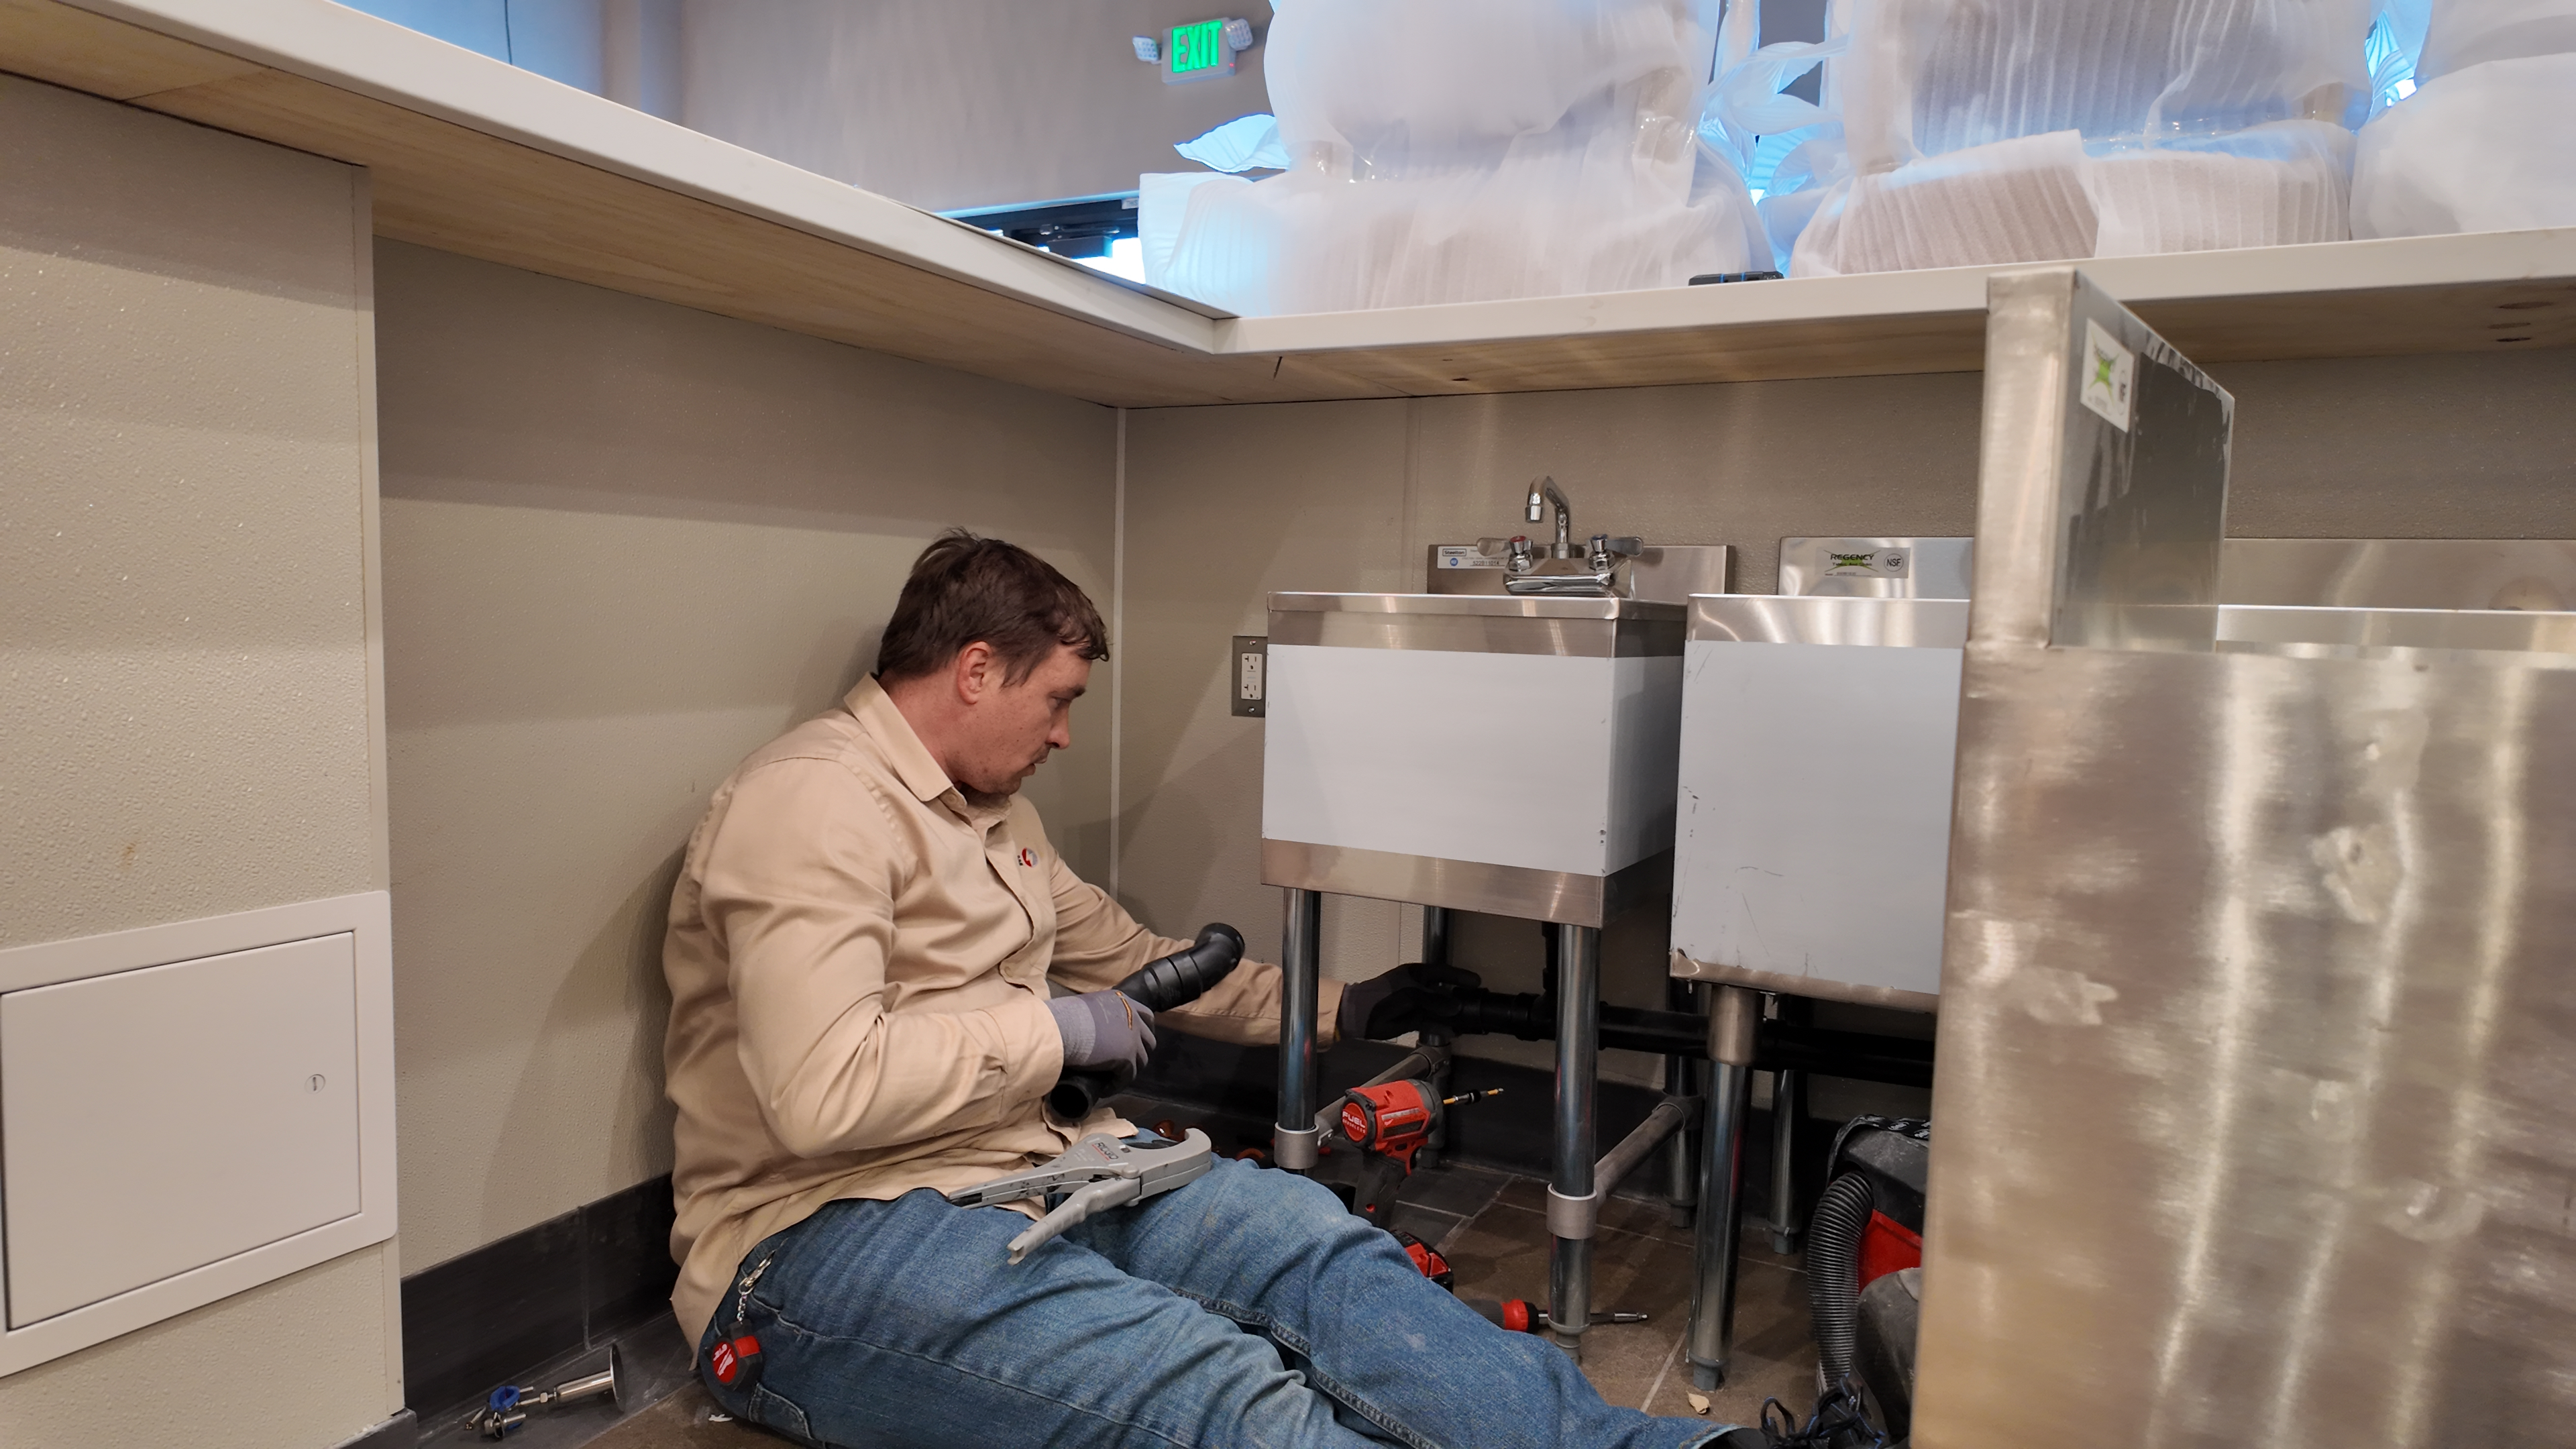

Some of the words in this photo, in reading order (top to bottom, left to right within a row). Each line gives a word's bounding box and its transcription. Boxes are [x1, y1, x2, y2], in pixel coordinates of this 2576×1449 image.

[1172, 20, 1223, 73] EXIT
[1886, 558, 1901, 567] NSF
[1342, 1111, 1366, 1128] FUEL
